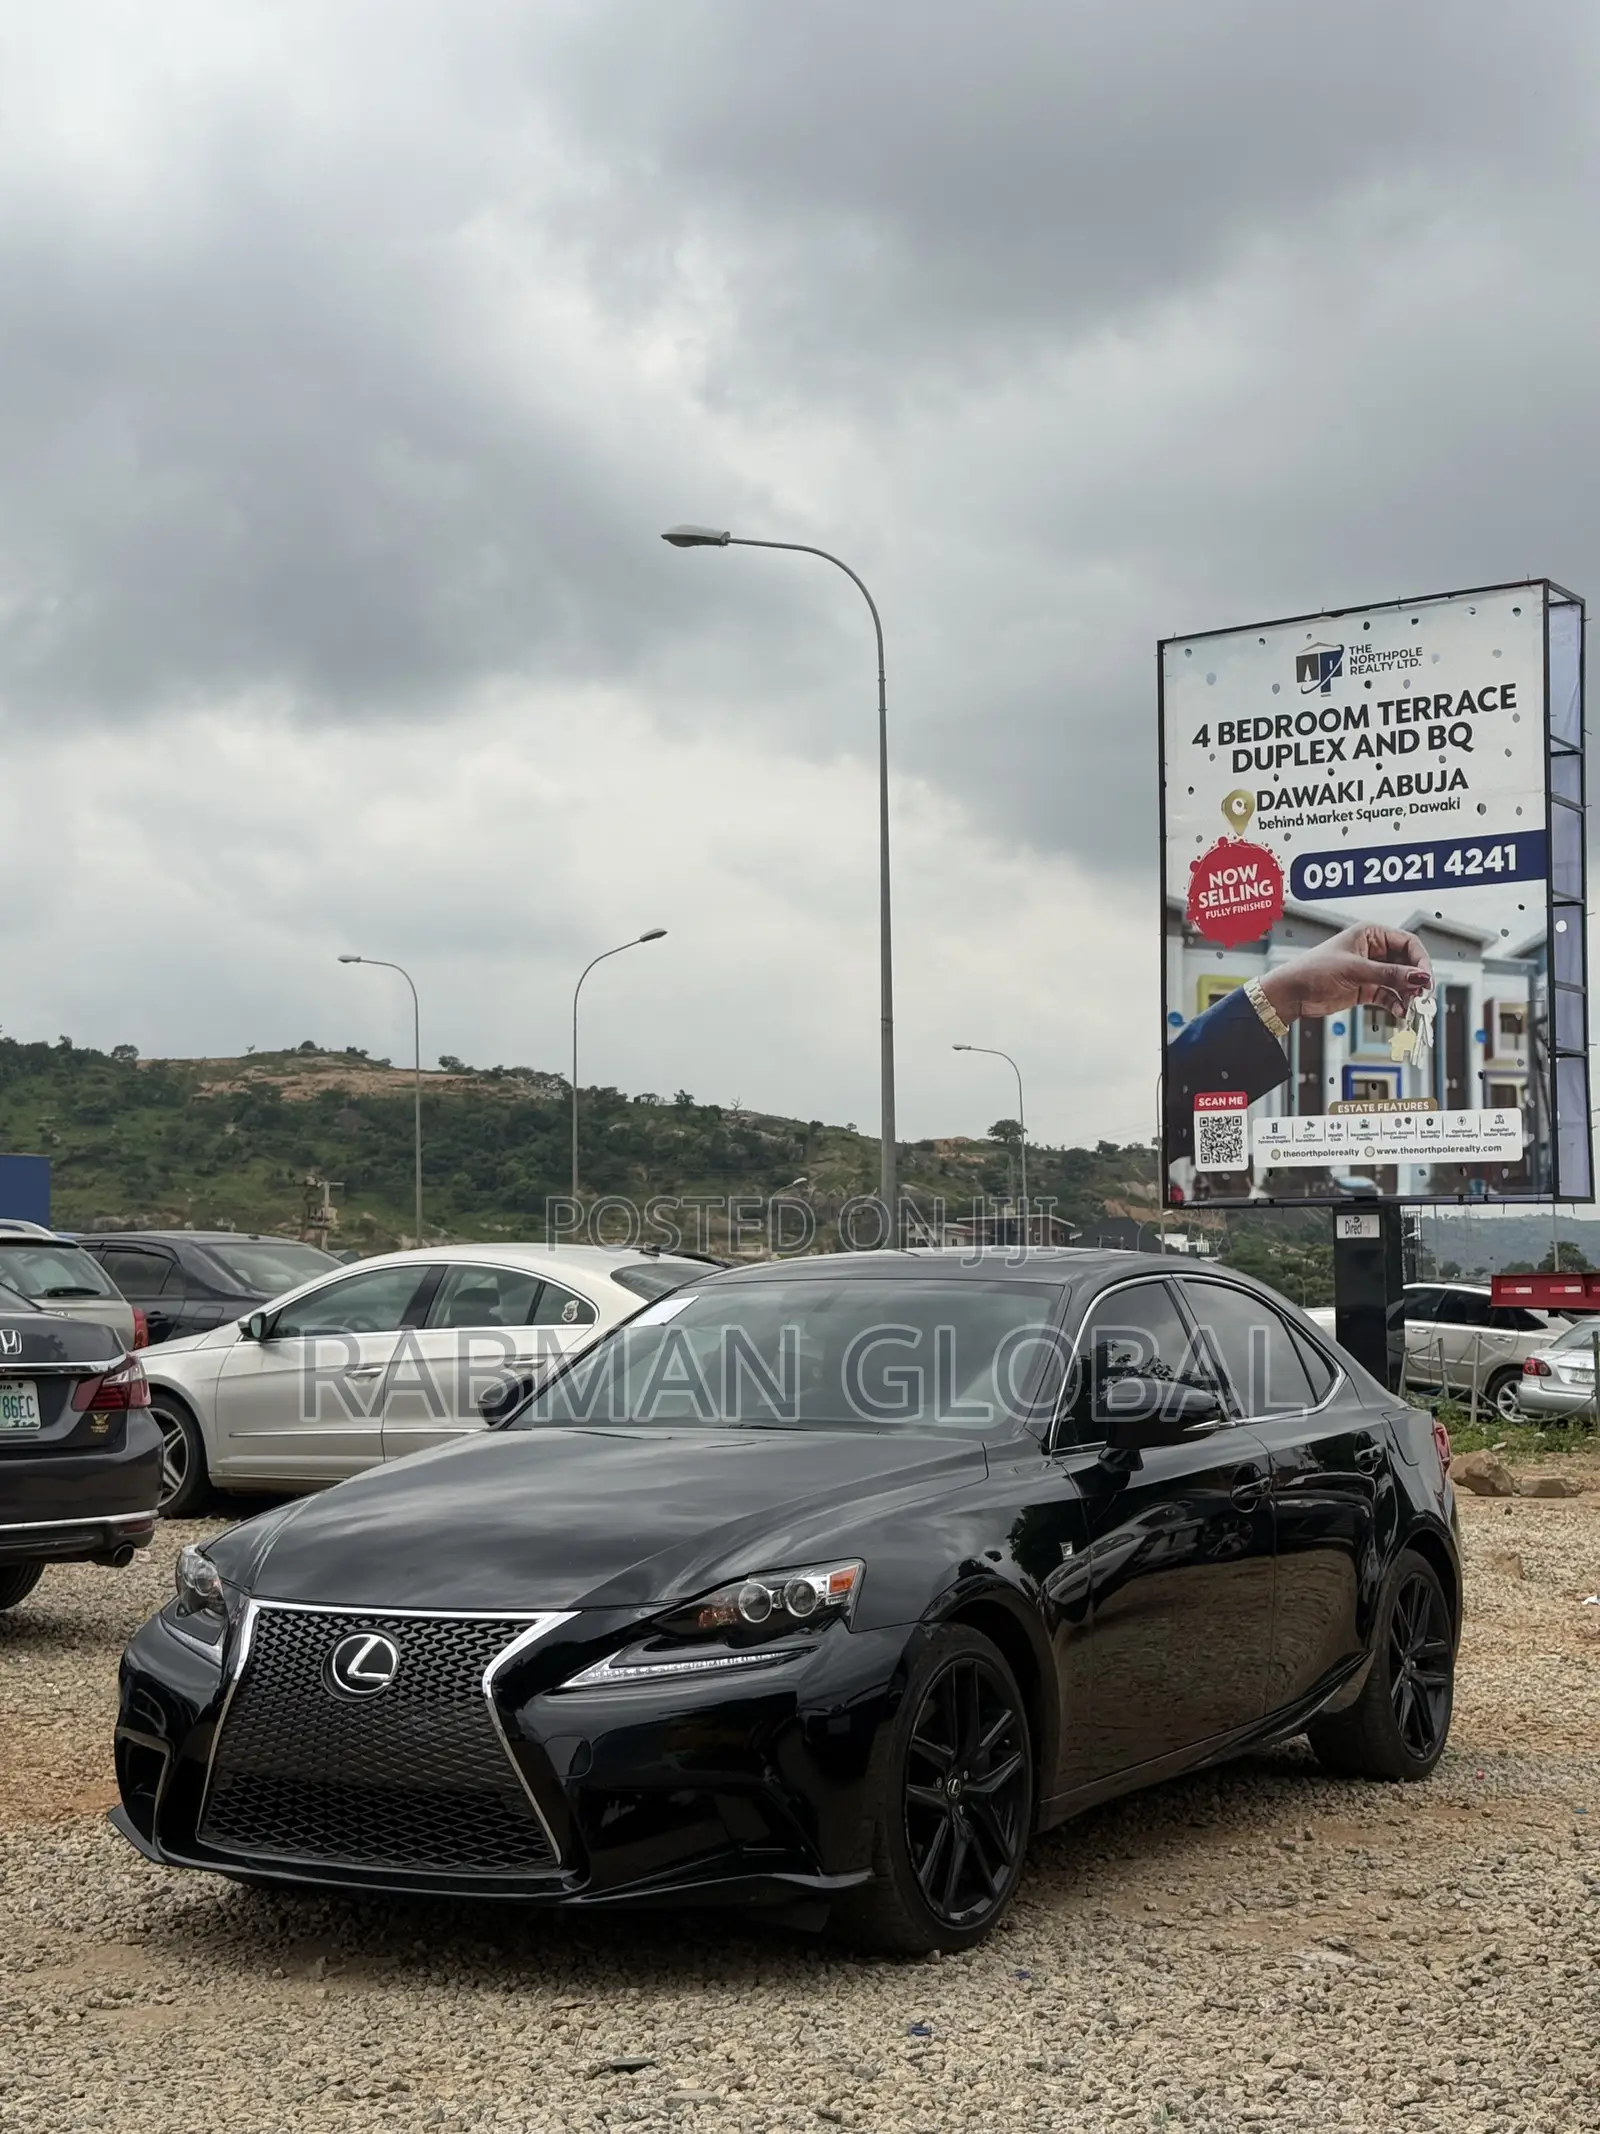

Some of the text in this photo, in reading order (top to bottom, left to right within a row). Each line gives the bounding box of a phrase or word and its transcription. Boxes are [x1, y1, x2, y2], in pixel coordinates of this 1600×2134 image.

[1349, 644, 1372, 655] THE
[1349, 647, 1423, 665] NORTHPOLE
[1350, 658, 1422, 675] REALTY LTD.
[1192, 683, 1517, 748] 4 BEDROOM TERRACE
[1232, 721, 1475, 773] DUPLEX AND BQ
[1256, 780, 1364, 812] DAWAKI
[1258, 797, 1461, 830] behind Market Square, Dawaki
[1208, 864, 1258, 888] NOW
[1303, 844, 1517, 890] 091 2021 4241
[1198, 880, 1274, 909] SELLING
[1205, 900, 1272, 919] FULLY FINISHED
[1198, 1096, 1243, 1107] SCAN ME
[1338, 1101, 1430, 1113] ESTATE FEATURES
[1283, 1148, 1360, 1158] thenorthpolerealty
[1376, 1144, 1502, 1155] www.thenorthpolerealty.com
